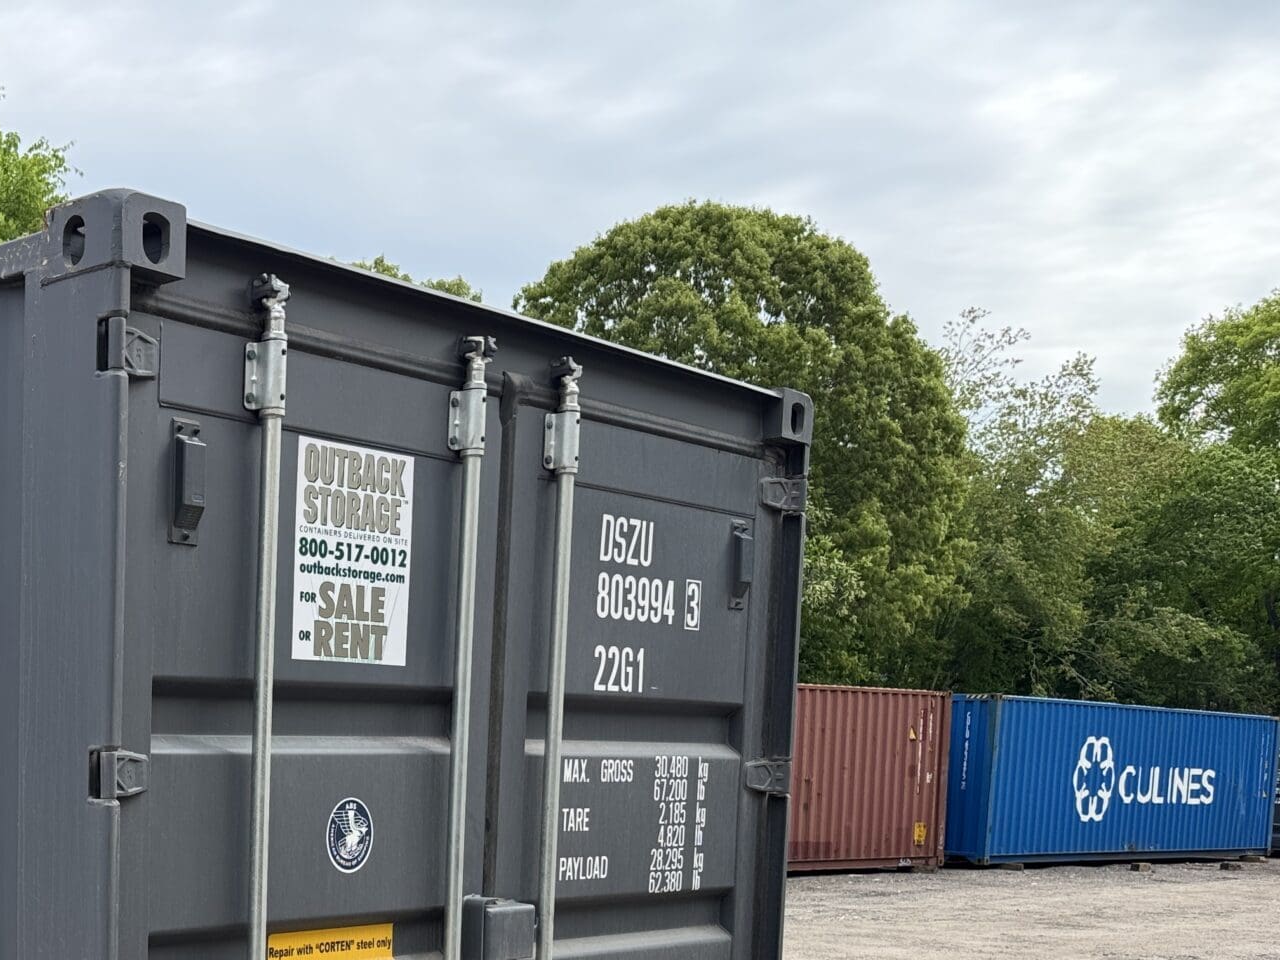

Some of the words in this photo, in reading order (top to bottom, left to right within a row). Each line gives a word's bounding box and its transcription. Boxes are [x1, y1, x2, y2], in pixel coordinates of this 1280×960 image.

[304, 443, 406, 497] OUTBACK
[303, 485, 402, 535] STORAGE
[299, 525, 342, 538] CONTAINERS
[344, 531, 380, 543] DELIVERED
[383, 535, 393, 544] ON
[394, 537, 409, 546] SITE
[599, 513, 654, 567] DSZU
[298, 537, 407, 568] 800-517-0012
[299, 560, 405, 583] outbackstorage.com
[300, 591, 317, 603] FOR
[318, 581, 386, 623] SALE
[596, 572, 675, 625] 803994
[685, 581, 701, 629] 3
[299, 630, 311, 641] OR
[313, 620, 388, 661] RENT
[593, 645, 645, 693] 22G1
[563, 759, 590, 783] MAX.
[600, 759, 634, 782] GROSS
[698, 756, 709, 782] kg
[1119, 765, 1215, 805] CULINES
[696, 780, 705, 800] lb
[562, 808, 590, 831] TARE
[695, 802, 706, 827] kg
[694, 825, 703, 846] lb
[559, 856, 608, 881] PAYLOAD
[693, 848, 704, 872] kg
[692, 870, 701, 891] lb
[269, 945, 294, 960] Repair
[296, 944, 313, 956] with
[356, 938, 375, 950] steel
[376, 936, 392, 950] only
